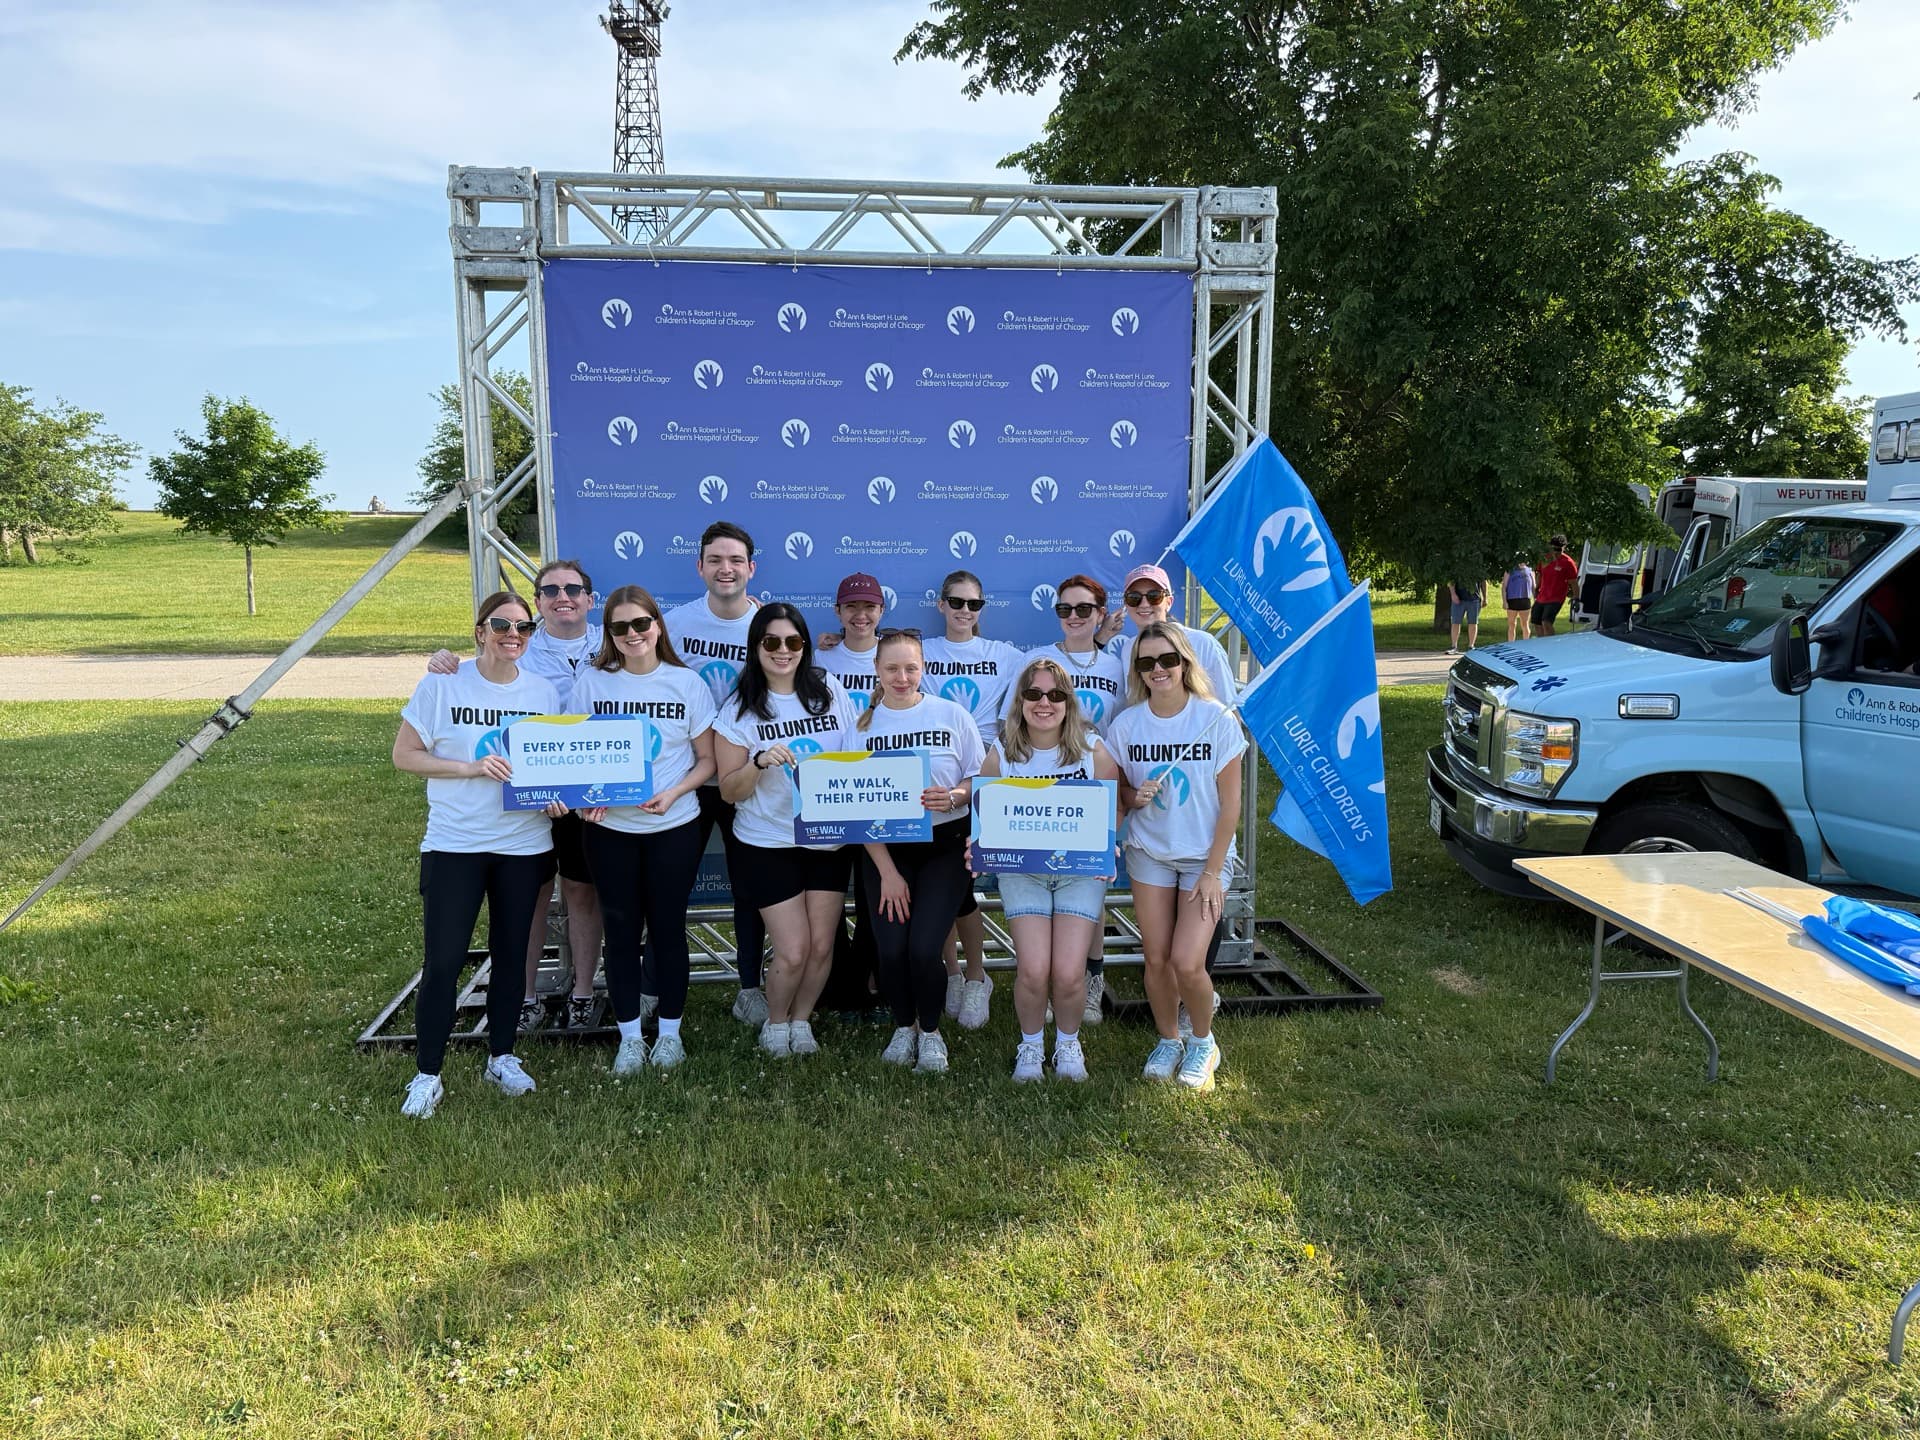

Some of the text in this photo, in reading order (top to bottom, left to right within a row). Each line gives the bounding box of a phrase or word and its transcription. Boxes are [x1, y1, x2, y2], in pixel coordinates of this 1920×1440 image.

[655, 316, 688, 324] Children's
[689, 318, 717, 326] Hospital
[829, 320, 860, 328] Children's
[861, 321, 888, 330] Hospital
[1028, 323, 1055, 332] Hospital
[570, 374, 603, 382] Children's
[604, 375, 632, 384] Hospital
[746, 377, 778, 385] Children's
[779, 378, 806, 387] Hospital
[947, 380, 974, 389] Hospital
[1110, 381, 1136, 389] Hospital
[661, 433, 693, 441] Children's
[694, 434, 722, 443] Hospital
[864, 436, 891, 444] Hospital
[1028, 436, 1054, 445] Hospital
[783, 492, 809, 501] Hospital
[1777, 488, 1796, 499] WE
[1800, 489, 1822, 500] PUT
[1825, 490, 1848, 500] THE
[1242, 581, 1292, 640] CHILDREN'S
[683, 637, 746, 661] VOLUNTE
[924, 661, 997, 676] VOLUNTEER
[1070, 675, 1118, 696] UNTEER
[1866, 698, 1886, 710] Ann
[1888, 701, 1896, 711] &
[593, 701, 686, 720] VOLUNTEER
[1836, 708, 1886, 724] Children's
[756, 715, 839, 741] VOLUNTEER
[524, 740, 631, 752] EVERY STEP FOR
[866, 731, 950, 752] VOLUNTEER
[1127, 743, 1211, 762] VOLUNTEER
[526, 753, 630, 766] CHICAGO'S KIDS
[828, 778, 895, 789] MY WALK,
[1284, 715, 1320, 758] LURIE
[1310, 756, 1373, 842] CHILDREN'S
[514, 790, 560, 800] THE WALK
[815, 791, 909, 804] THEIR FUTURE
[1004, 805, 1084, 818] I MOVE FOR
[820, 826, 846, 835] WALK
[1009, 820, 1078, 832] RESEARCH
[982, 853, 1024, 863] THE WALK
[702, 873, 722, 881] Lurie
[706, 882, 732, 891] Chica
